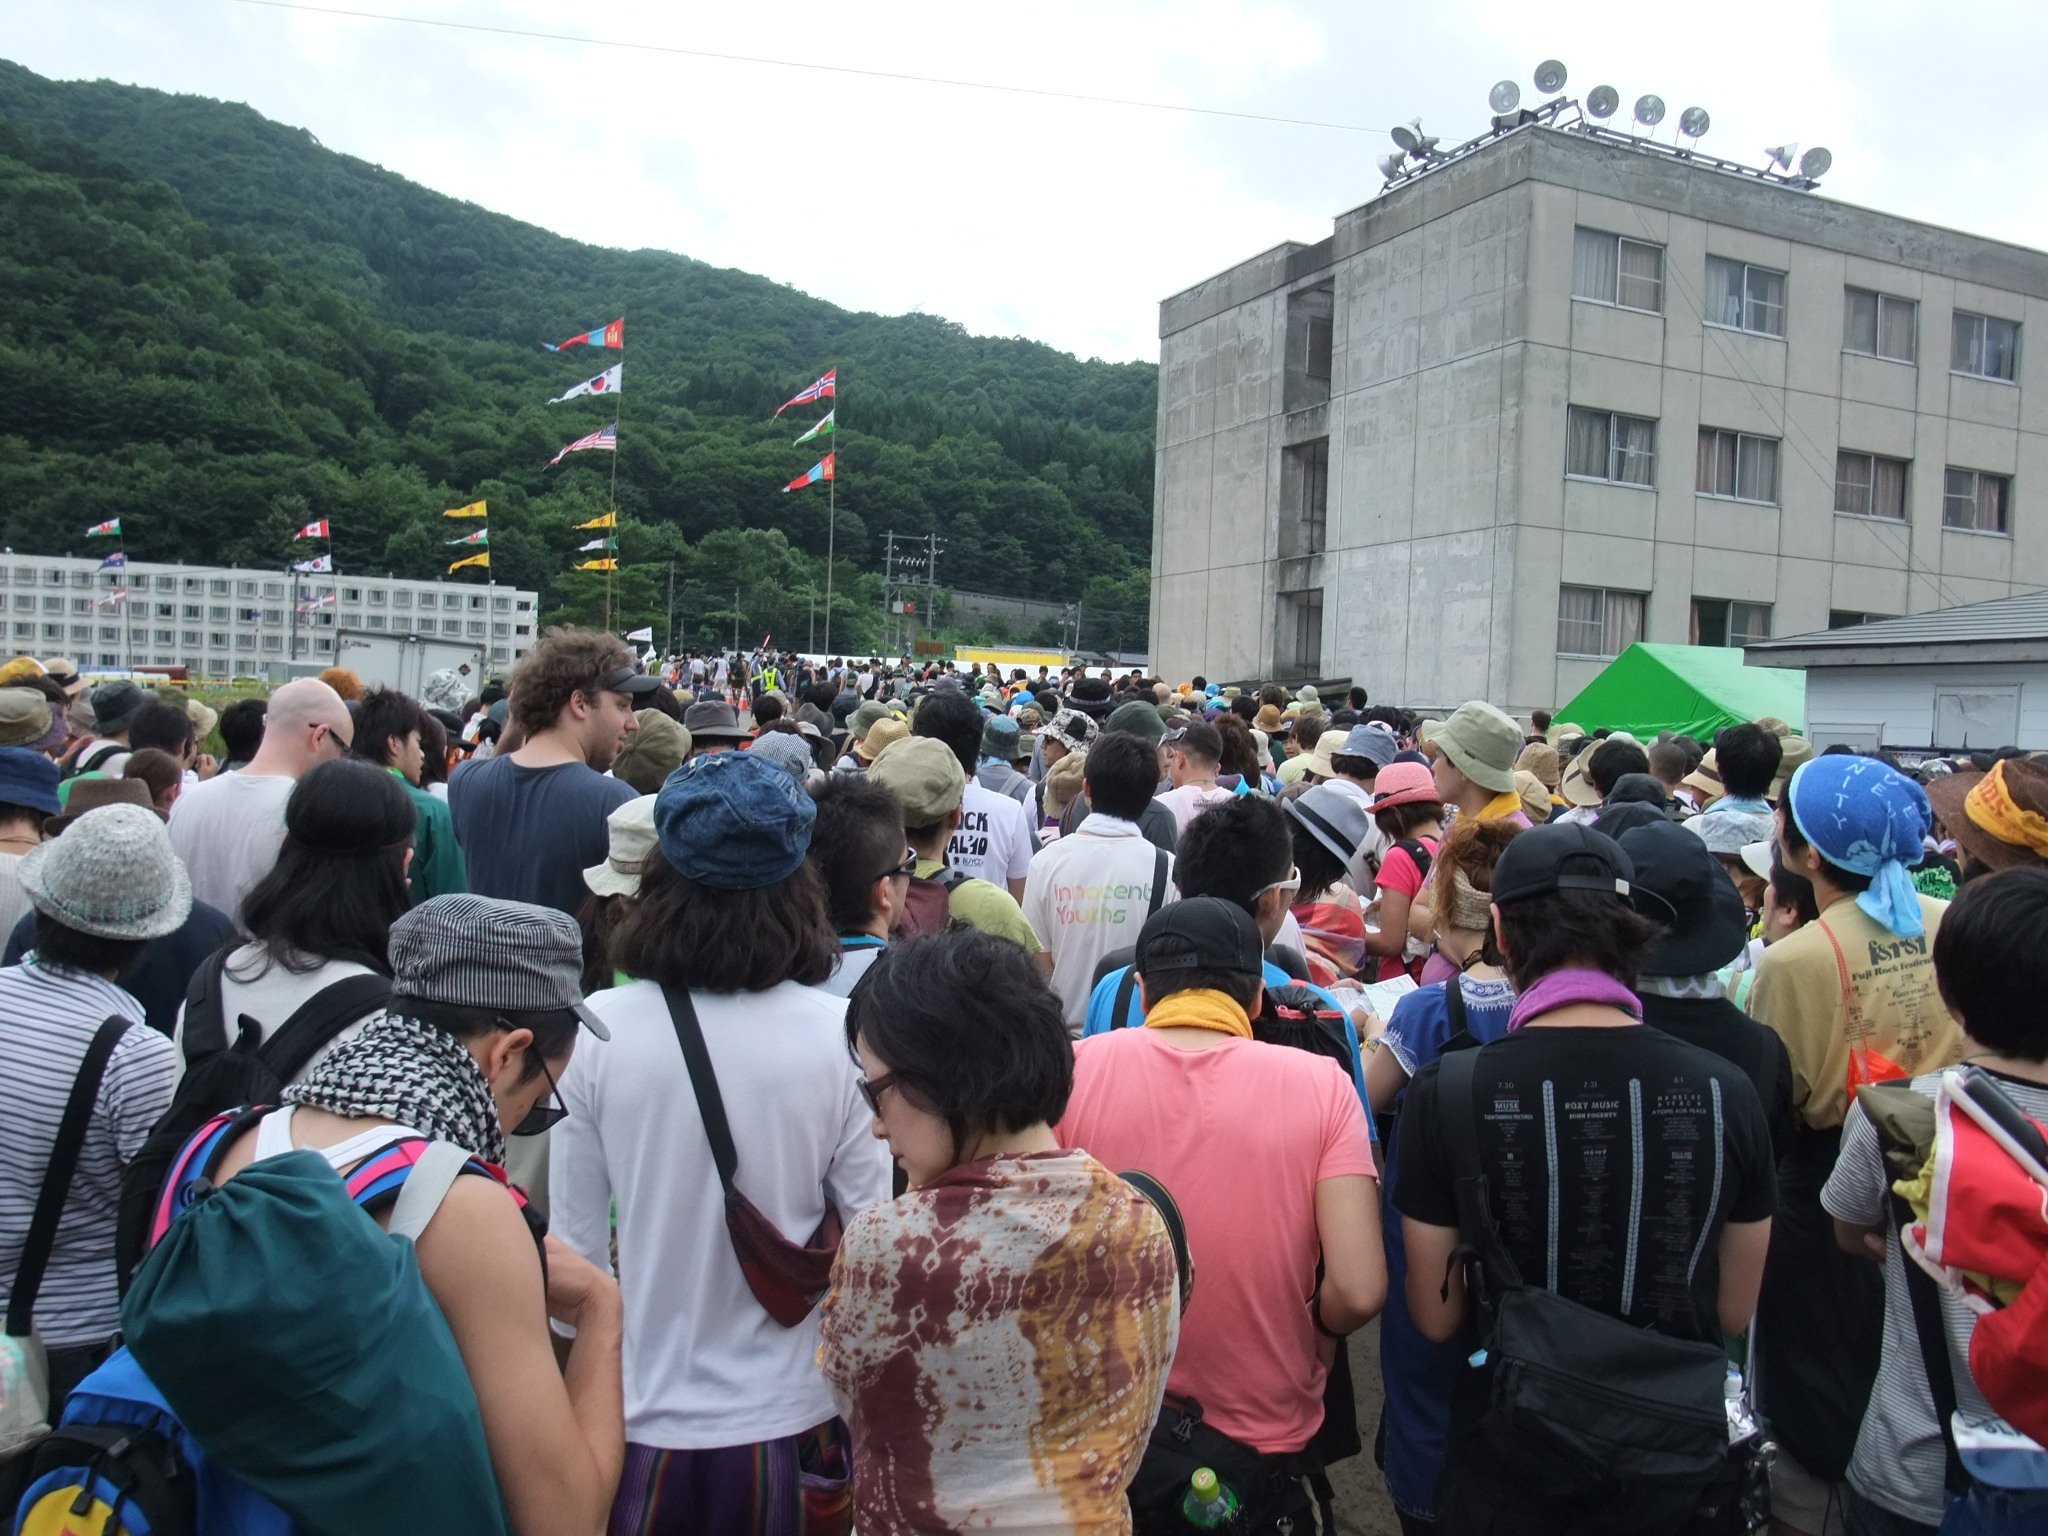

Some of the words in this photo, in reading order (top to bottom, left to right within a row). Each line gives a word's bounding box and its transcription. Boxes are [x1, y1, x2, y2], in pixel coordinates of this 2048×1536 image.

[1055, 883, 1152, 901] Innocent
[1056, 904, 1126, 925] Youths
[1852, 970, 1872, 981] Fuji
[1874, 965, 1899, 976] Rock
[1494, 1102, 1520, 1110] MUSE
[1565, 1101, 1588, 1110] ROXY
[1591, 1101, 1620, 1109] MUSIC
